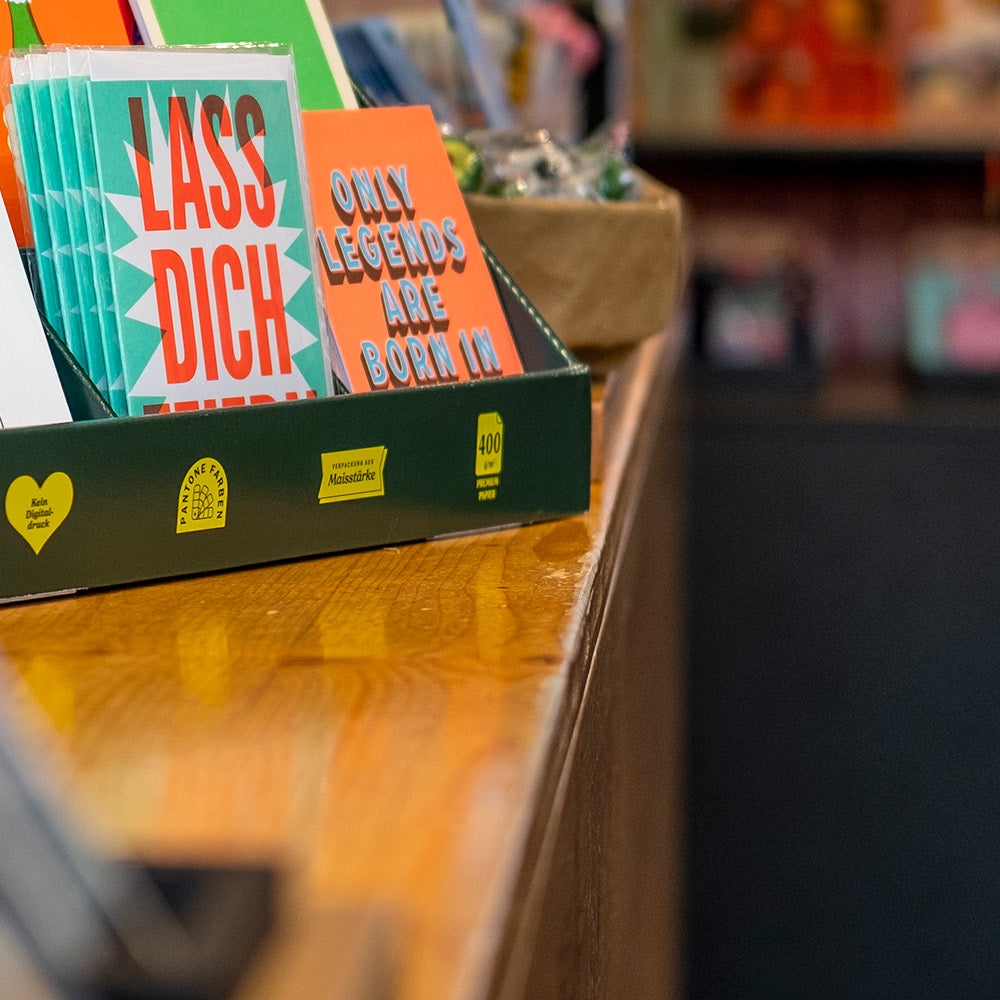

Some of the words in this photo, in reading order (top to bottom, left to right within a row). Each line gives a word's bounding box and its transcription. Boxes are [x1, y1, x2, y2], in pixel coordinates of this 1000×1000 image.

[127, 93, 277, 232] LASS
[331, 166, 416, 225] ONLY
[316, 218, 467, 286] LEGENDS
[150, 243, 293, 385] DICH
[380, 276, 450, 337] ARE
[360, 332, 460, 392] BORN
[458, 327, 503, 380] IN
[478, 431, 501, 456] 400
[30, 497, 48, 507] Kein
[180, 463, 207, 525] PANTONE
[209, 464, 225, 519] FARBEN
[327, 468, 376, 487] Maisstärke
[26, 519, 50, 530] druck
